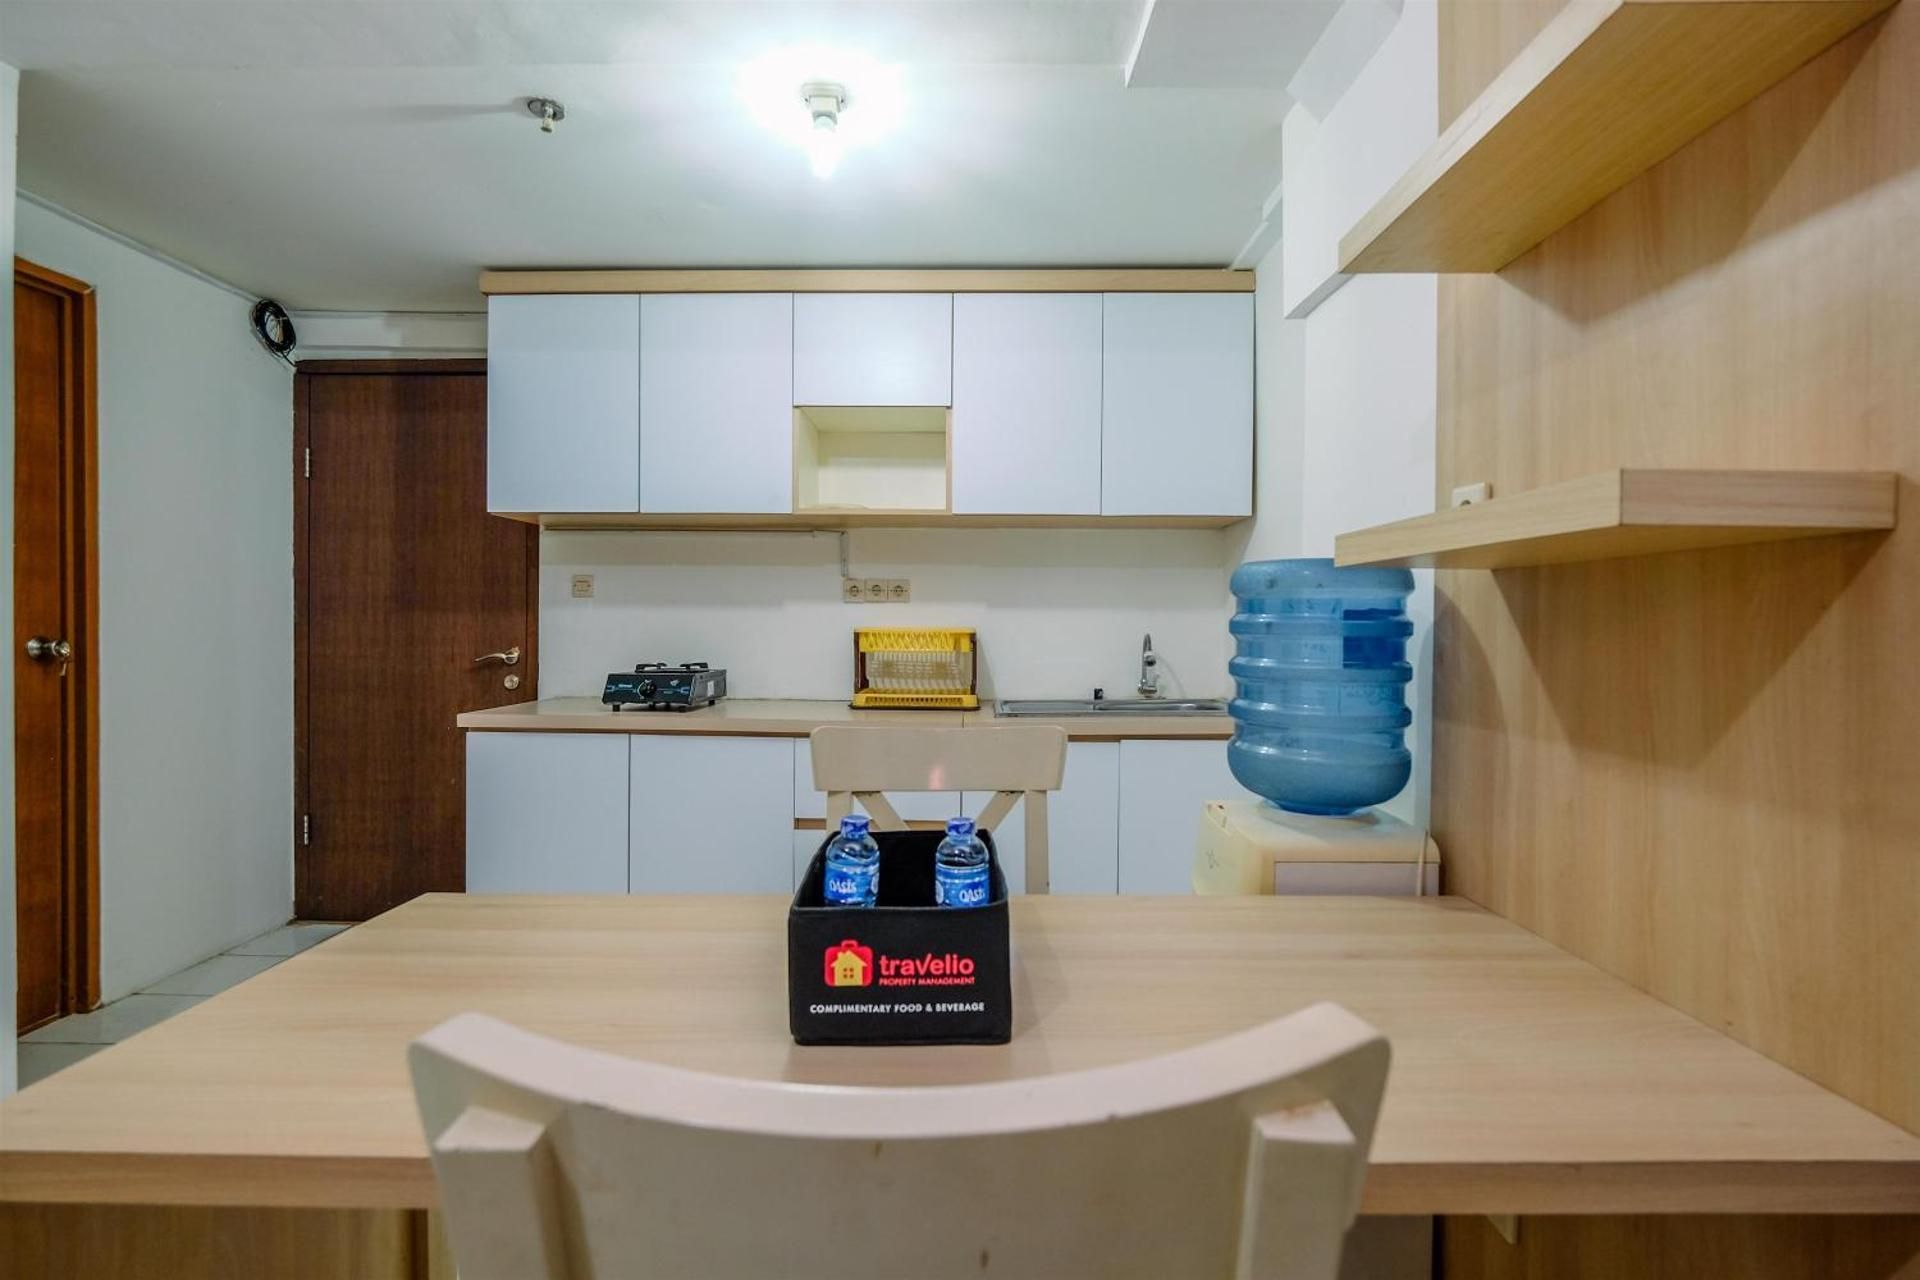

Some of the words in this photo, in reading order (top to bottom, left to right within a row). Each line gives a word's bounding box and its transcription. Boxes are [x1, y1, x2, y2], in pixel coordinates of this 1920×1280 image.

[879, 953, 975, 976] travelio
[879, 977, 916, 986] PROPERTY
[918, 976, 975, 985] MANAGEMENT
[810, 1004, 891, 1014] COMPLIMENTARY
[894, 1003, 922, 1013] FOOD
[925, 1003, 933, 1012] &
[935, 1002, 985, 1012] BEVERAGE
